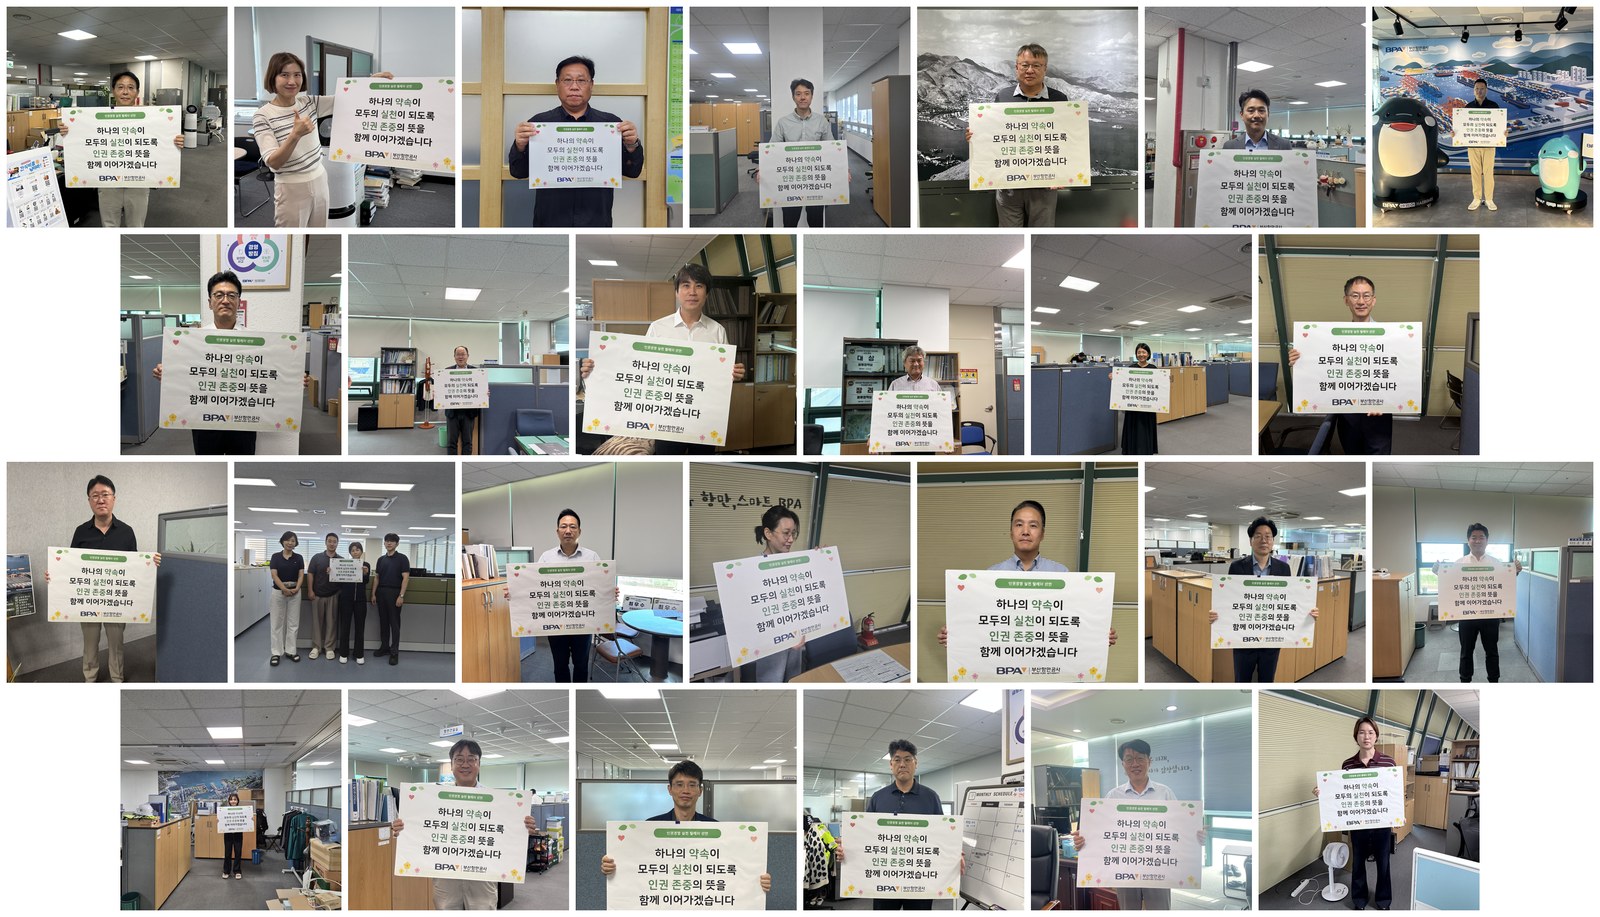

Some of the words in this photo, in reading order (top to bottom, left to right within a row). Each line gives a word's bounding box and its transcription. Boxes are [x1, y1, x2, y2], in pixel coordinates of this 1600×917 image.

[369, 97, 393, 107] 하나의
[395, 98, 421, 108] 약속이
[354, 109, 379, 118] 모두의
[381, 110, 406, 120] 실천이
[408, 111, 436, 122] 되도록
[96, 127, 120, 135] 하나의
[121, 126, 145, 136] 약속이
[362, 121, 378, 131] 인권
[379, 122, 405, 133] 존중의
[407, 123, 426, 135] 뜻을
[1005, 122, 1029, 131] 하나의
[1031, 121, 1054, 131] 약속이
[85, 138, 108, 147] 모두의
[109, 138, 132, 147] 실천이
[134, 138, 159, 147] 되도록
[354, 133, 370, 143] 함께
[372, 134, 433, 147] 이어가겠습니다
[992, 134, 1017, 144] 모두의
[1018, 133, 1042, 143] 실천이
[1044, 133, 1068, 142] 되도록
[93, 149, 108, 158] 인권
[110, 149, 133, 159] 존중의
[134, 149, 151, 159] 뜻을
[364, 150, 386, 159] BPA
[1001, 146, 1017, 156] 인권
[1018, 145, 1042, 155] 존중의
[1044, 145, 1061, 155] 뜻을
[86, 160, 102, 170] 함께
[104, 160, 158, 170] 이어가겠습니다
[994, 158, 1010, 169] 함께
[1012, 157, 1068, 168] 이어가겠습니다
[1006, 174, 1027, 182] BPA
[1332, 343, 1357, 353] 하나의
[1359, 343, 1384, 354] 약속이
[205, 352, 233, 364] 하나의
[235, 354, 263, 366] 약속이
[1318, 356, 1344, 366] 모두의
[1345, 356, 1371, 366] 실천이
[1373, 356, 1399, 366] 되도록
[632, 359, 660, 373] 하나의
[663, 363, 691, 376] 약속이
[189, 366, 217, 378] 모두의
[219, 368, 247, 379] 실천이
[249, 369, 278, 381] 되도록
[1327, 369, 1343, 379] 인권
[1345, 369, 1371, 379] 존중의
[1372, 369, 1390, 379] 뜻을
[615, 372, 644, 385] 모두의
[646, 375, 674, 388] 실천이
[676, 379, 705, 392] 되도록
[1319, 381, 1336, 392] 함께
[1338, 381, 1398, 392] 이어가겠습니다
[198, 381, 217, 392] 인권
[219, 381, 247, 393] 존중의
[249, 383, 268, 395] 뜻을
[189, 394, 208, 406] 함께
[210, 395, 276, 408] 이어가겠습니다
[623, 387, 642, 400] 인권
[644, 389, 673, 403] 존중의
[675, 393, 695, 405] 뜻을
[1332, 398, 1354, 406] BPA
[614, 400, 633, 413] 함께
[635, 403, 702, 419] 이어가겠습니다
[203, 413, 227, 422] BPA
[626, 421, 651, 431] BPA
[1243, 592, 1264, 601] 하나의
[1266, 593, 1287, 602] 약속이
[996, 598, 1028, 611] 하나의
[1031, 599, 1064, 612] 약속이
[1232, 603, 1253, 611] 모두의
[1254, 603, 1275, 611] 실천이
[1276, 603, 1297, 612] 되도록
[978, 615, 1011, 627] 모두의
[1013, 615, 1045, 627] 실천이
[1048, 615, 1081, 628] 되도록
[1239, 613, 1253, 621] 인권
[1254, 613, 1275, 622] 존중의
[1276, 613, 1290, 622] 뜻을
[1232, 623, 1247, 631] 함께
[1248, 623, 1296, 632] 이어가겠습니다
[773, 631, 796, 645] BPA
[989, 630, 1010, 643] 인권
[1013, 631, 1045, 643] 존중의
[1048, 631, 1070, 644] 뜻을
[979, 646, 1001, 658] 함께
[1004, 646, 1079, 659] 이어가겠습니다
[996, 666, 1024, 676] BPA
[438, 807, 463, 818] 하나의
[466, 809, 492, 820] 약속이
[423, 819, 449, 830] 모두의
[451, 821, 476, 832] 실천이
[478, 823, 505, 835] 되도록
[431, 833, 448, 844] 인권
[450, 834, 476, 845] 존중의
[477, 836, 496, 847] 뜻을
[877, 833, 901, 843] 하나의
[903, 834, 928, 844] 약속이
[422, 845, 440, 856] 함께
[442, 846, 502, 860] 이어가겠습니다
[655, 848, 686, 860] 하나의
[689, 848, 720, 860] 약속이
[864, 845, 888, 855] 모두의
[890, 846, 914, 856] 실천이
[916, 847, 941, 857] 되도록
[434, 863, 457, 872] BPA
[872, 857, 888, 867] 인권
[890, 858, 914, 868] 존중의
[915, 858, 932, 868] 뜻을
[637, 863, 669, 876] 모두의
[672, 863, 703, 876] 실천이
[705, 864, 737, 876] 되도록
[864, 869, 881, 879] 함께
[883, 869, 939, 880] 이어가겠습니다
[1115, 873, 1136, 881] BPA
[648, 879, 669, 891] 인권
[671, 879, 703, 891] 존중의
[705, 879, 727, 892] 뜻을
[639, 894, 660, 907] 함께
[662, 894, 736, 907] 이어가겠습니다
